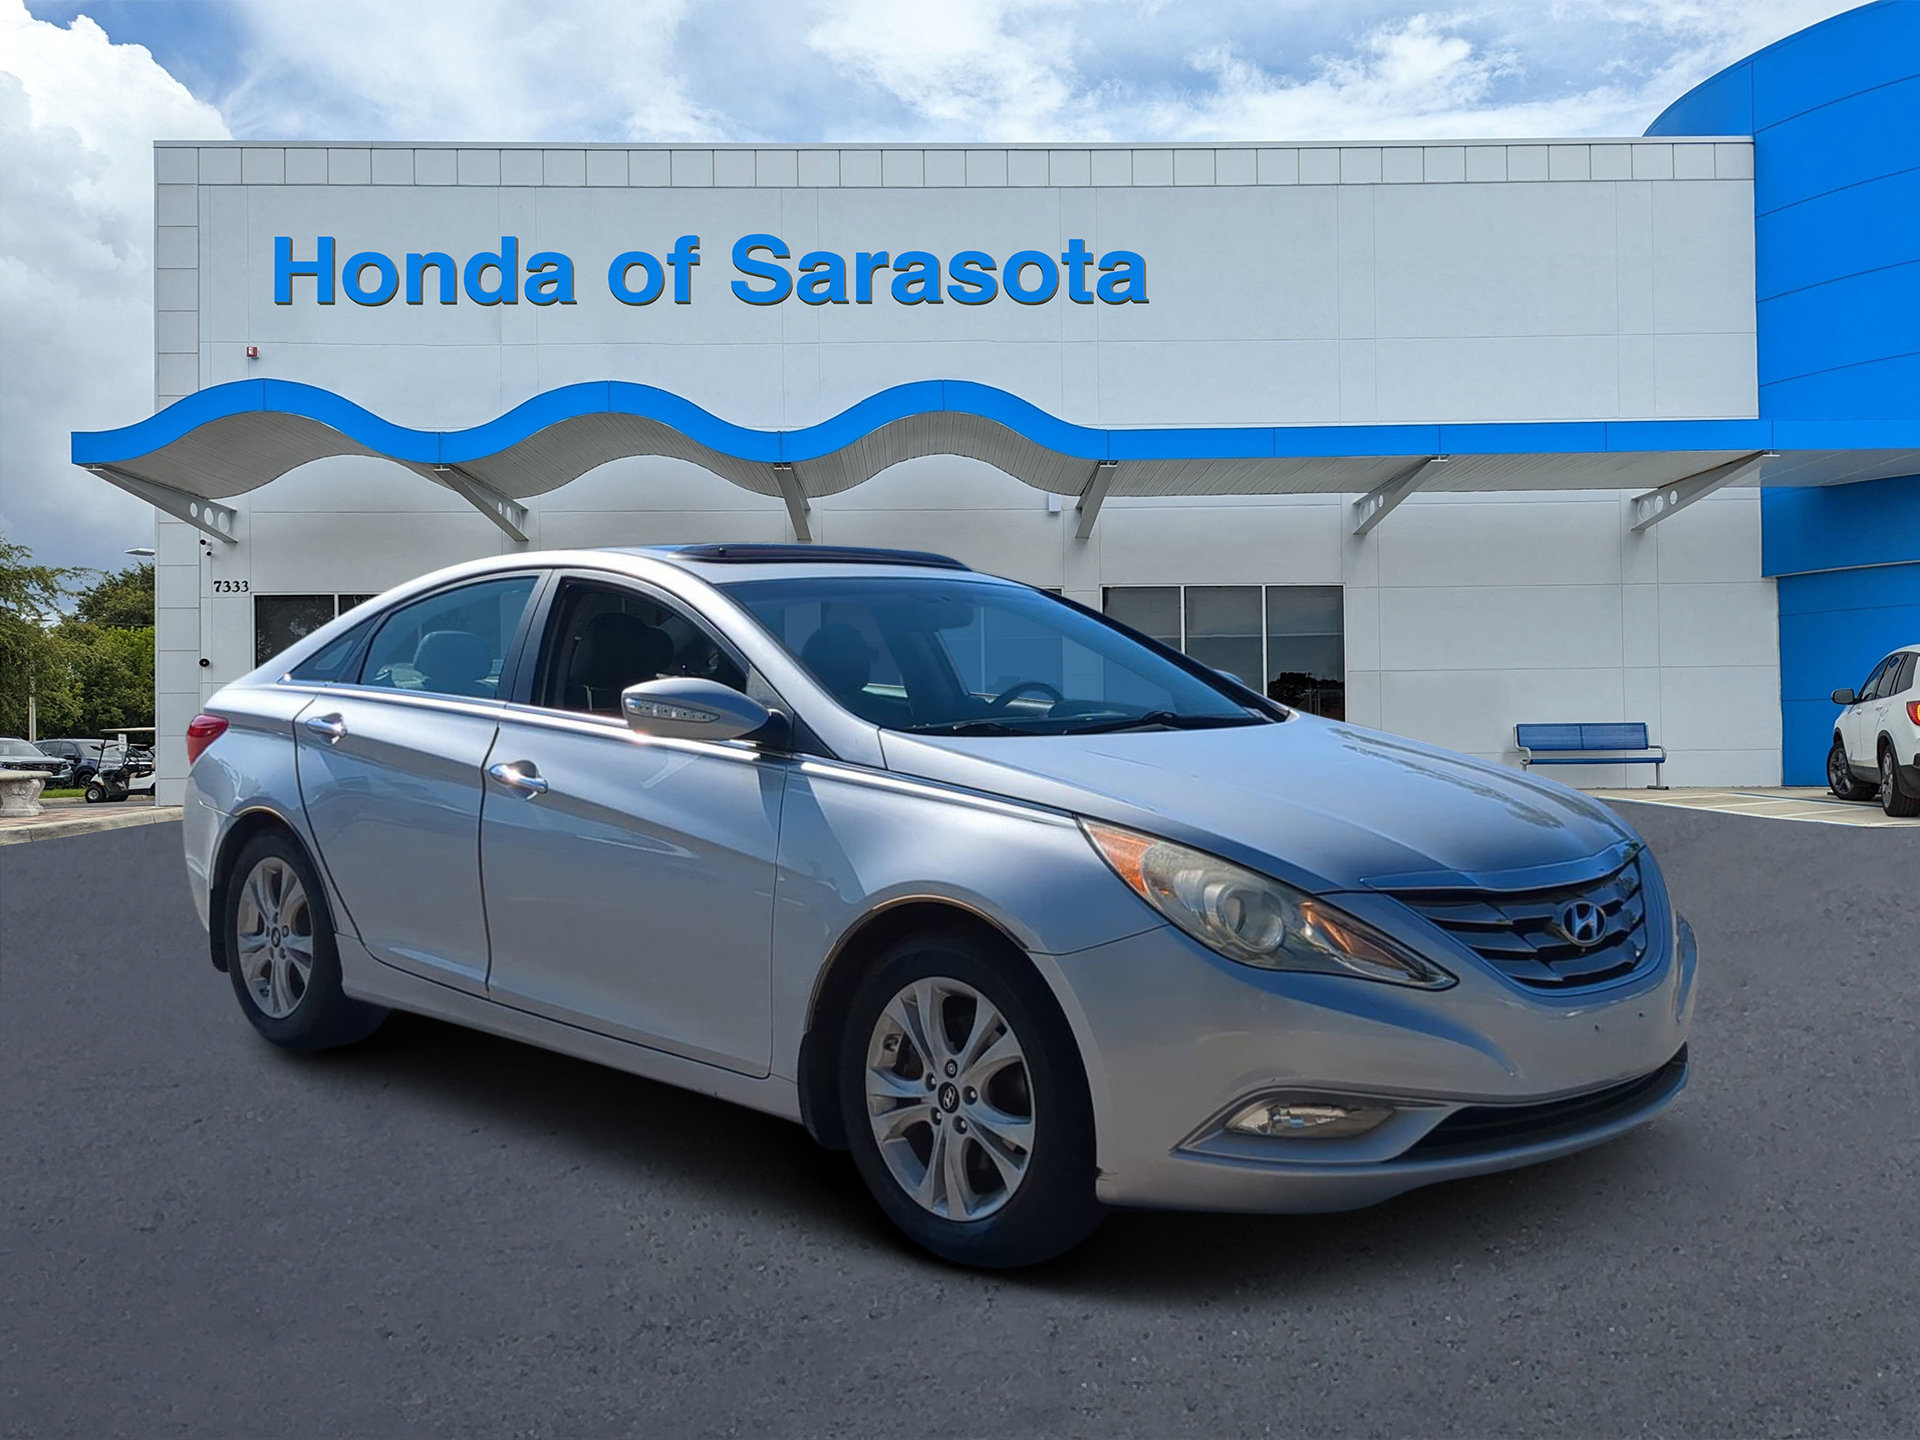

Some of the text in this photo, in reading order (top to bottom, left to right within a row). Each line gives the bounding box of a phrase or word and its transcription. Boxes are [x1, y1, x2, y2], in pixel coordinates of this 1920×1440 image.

[274, 234, 1149, 307] Honda of Sarasota
[213, 580, 249, 593] 7333
